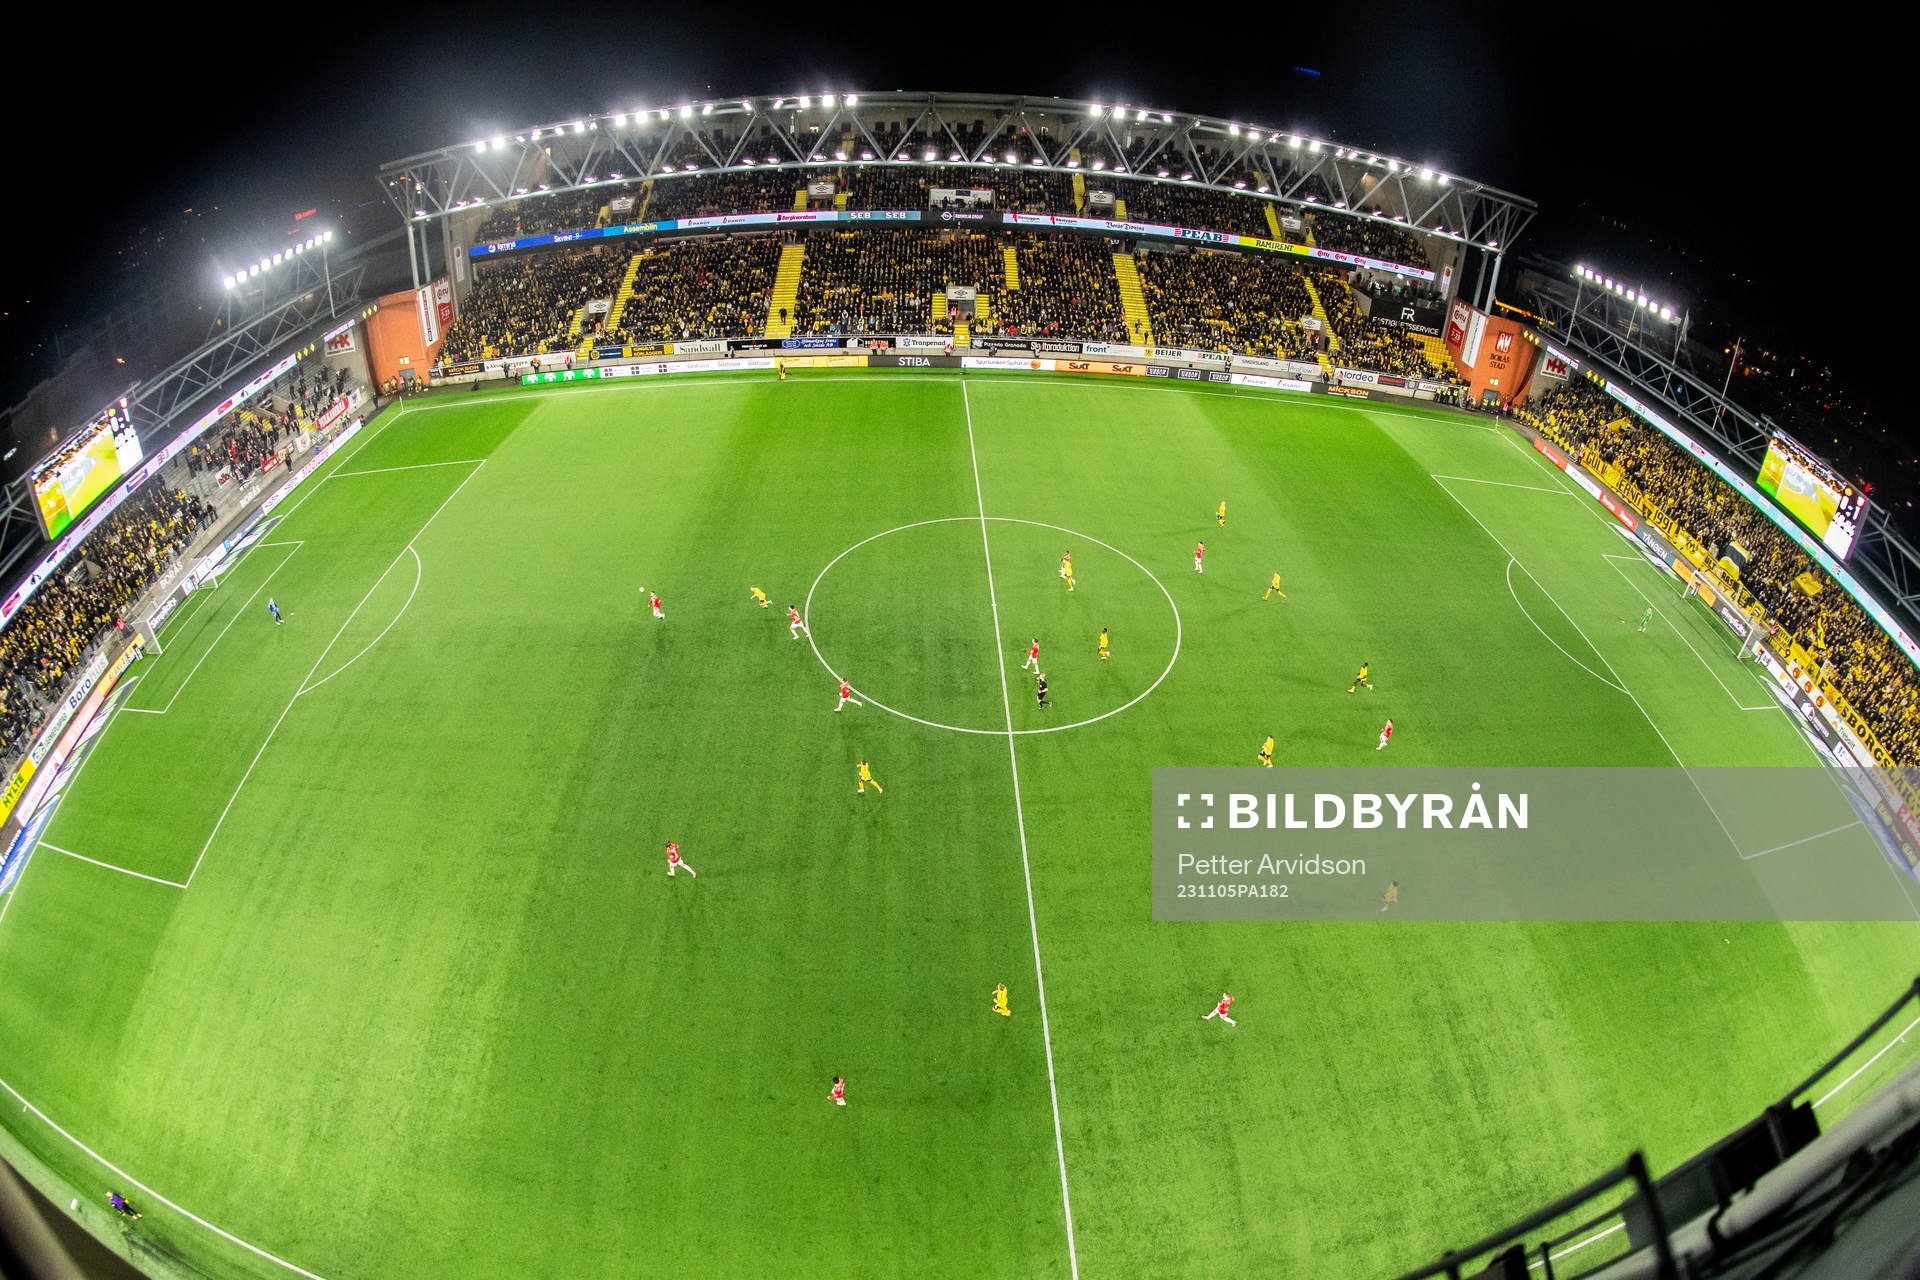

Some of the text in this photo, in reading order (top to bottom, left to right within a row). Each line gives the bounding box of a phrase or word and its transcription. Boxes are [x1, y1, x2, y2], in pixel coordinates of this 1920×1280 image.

[623, 223, 658, 234] Assemblin
[1181, 229, 1222, 242] PEAB
[1255, 239, 1295, 252] RAMIRENT
[1401, 307, 1415, 321] FR
[679, 343, 721, 353] Sandwall
[1154, 349, 1183, 358] BEIJER
[898, 357, 930, 366] STIBA
[1328, 386, 1369, 396] MICKSON
[1653, 509, 1673, 533] 1991
[150, 598, 177, 629] Simplicity
[1720, 607, 1748, 636] Simplicity
[3, 774, 25, 807] HYLTE
